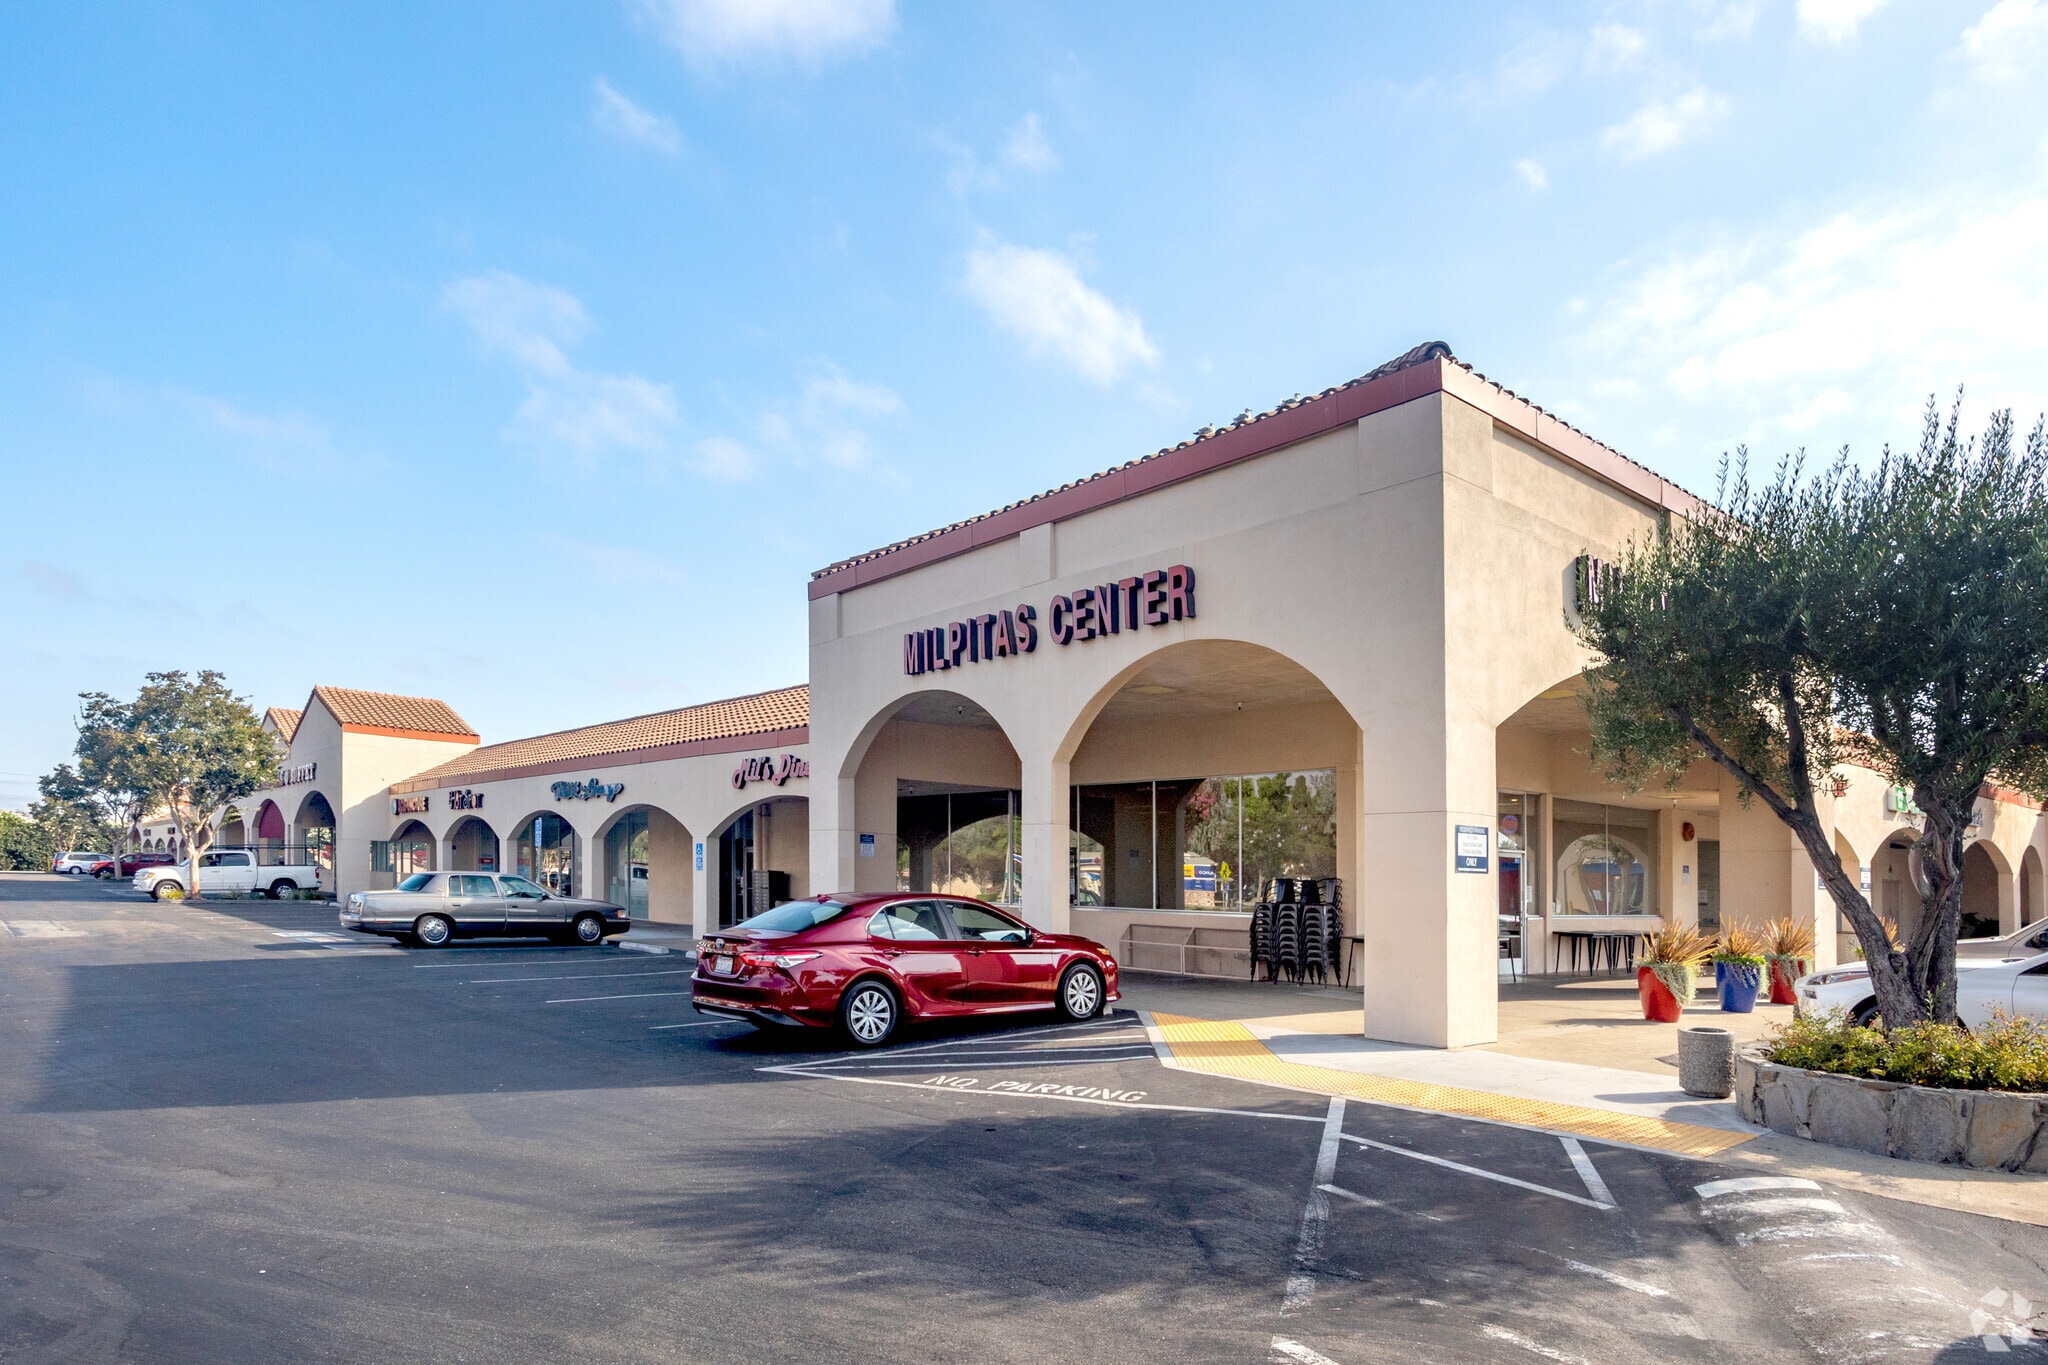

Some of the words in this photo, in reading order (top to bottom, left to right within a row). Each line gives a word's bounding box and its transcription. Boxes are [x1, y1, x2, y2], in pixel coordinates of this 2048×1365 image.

[904, 603, 1037, 675] MILPITAS
[1049, 564, 1196, 645] CENTER
[732, 756, 773, 789] Mil's
[772, 754, 809, 786] Dine
[1466, 857, 1478, 867] ONLY
[923, 1075, 979, 1090] NO
[987, 1080, 1148, 1102] PARKING
